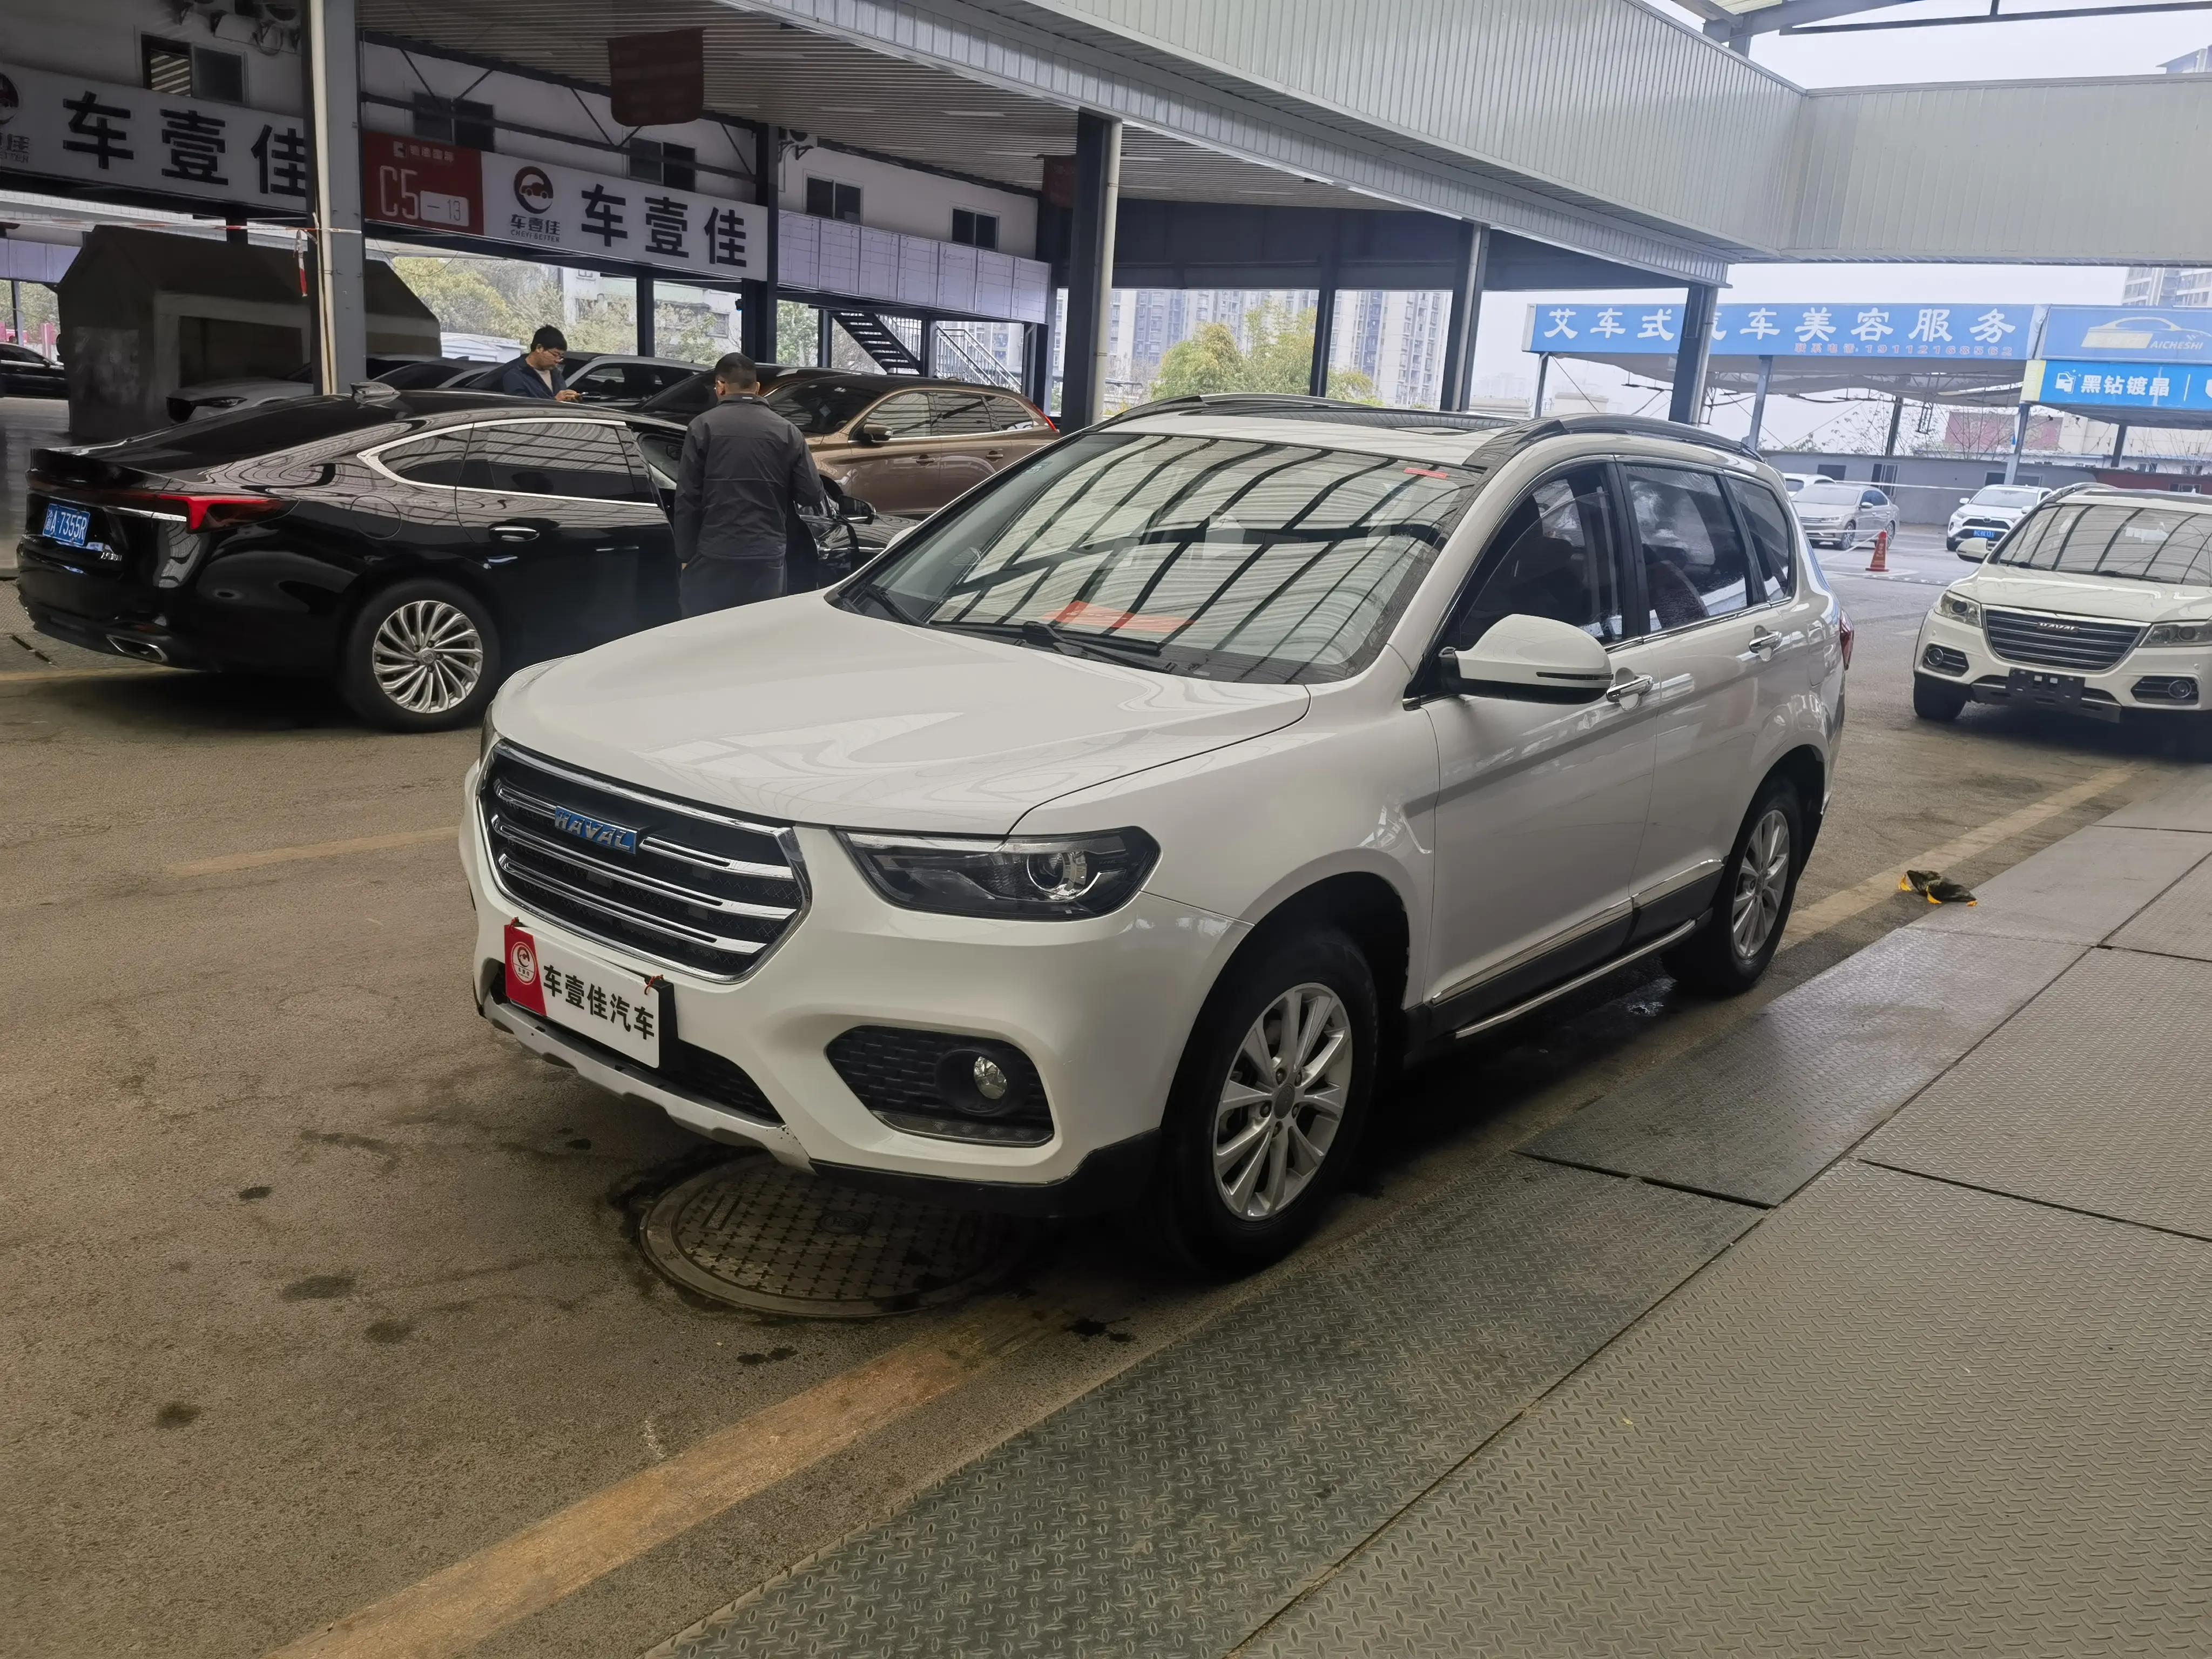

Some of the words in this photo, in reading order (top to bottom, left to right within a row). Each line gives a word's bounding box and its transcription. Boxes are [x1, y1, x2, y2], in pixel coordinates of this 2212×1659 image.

[63, 90, 306, 197] 车壹佳
[510, 214, 561, 235] 车壹佳
[581, 184, 747, 268] 车壹佳
[2149, 340, 2204, 350] AICHESHI
[2080, 374, 2170, 397] 黑钻镀晶
[555, 811, 632, 852] HAVAL
[542, 964, 656, 1040] 车壹佳汽车
